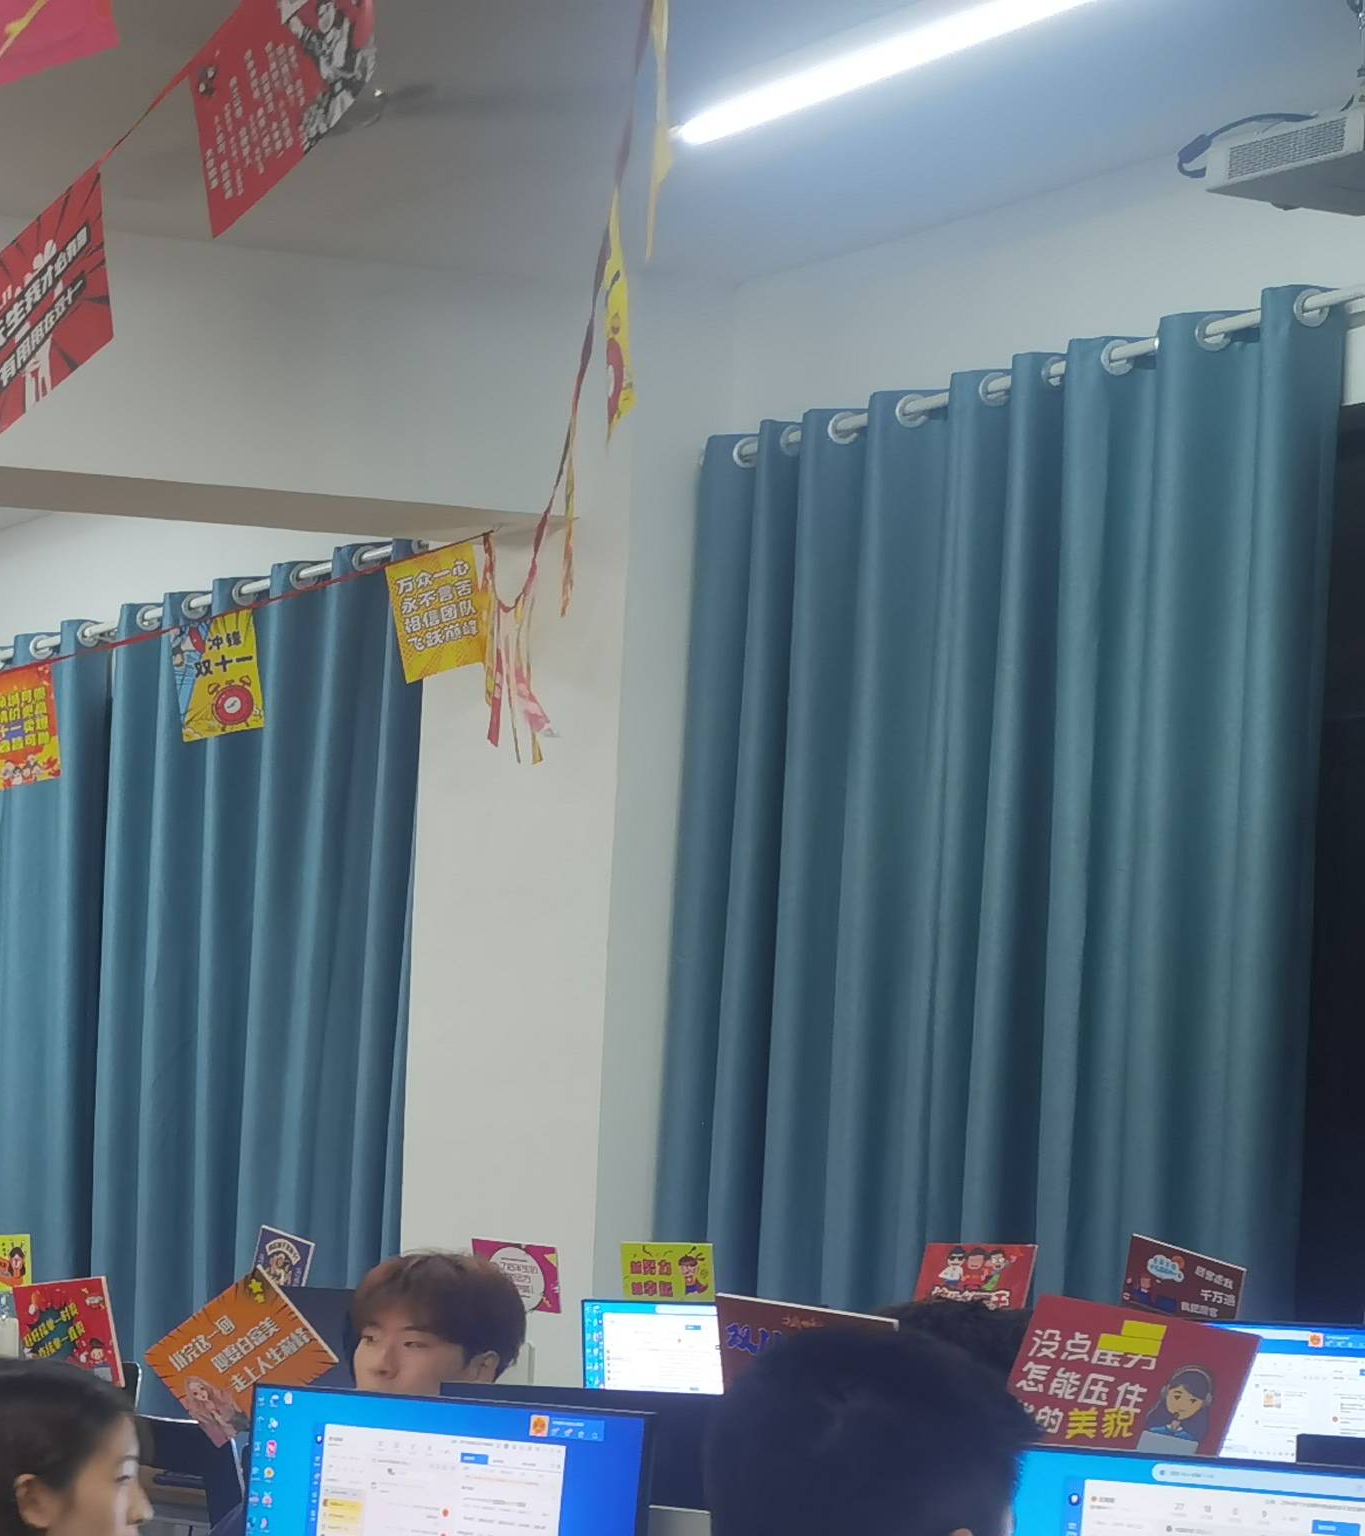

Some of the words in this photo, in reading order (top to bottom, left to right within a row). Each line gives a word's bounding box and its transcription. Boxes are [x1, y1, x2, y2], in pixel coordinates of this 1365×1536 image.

[396, 558, 470, 596] 万众一心
[400, 580, 474, 616] 永不言苦
[404, 601, 477, 634] 相信团队
[407, 620, 479, 653] 飞跃巅峰
[193, 652, 254, 678] 双十一
[211, 1316, 281, 1374] 迎娶白富美
[229, 1327, 312, 1393] 走上人生巅峰
[1015, 1360, 1148, 1412] 怎能压住
[1023, 1401, 1136, 1440] 的美貌
